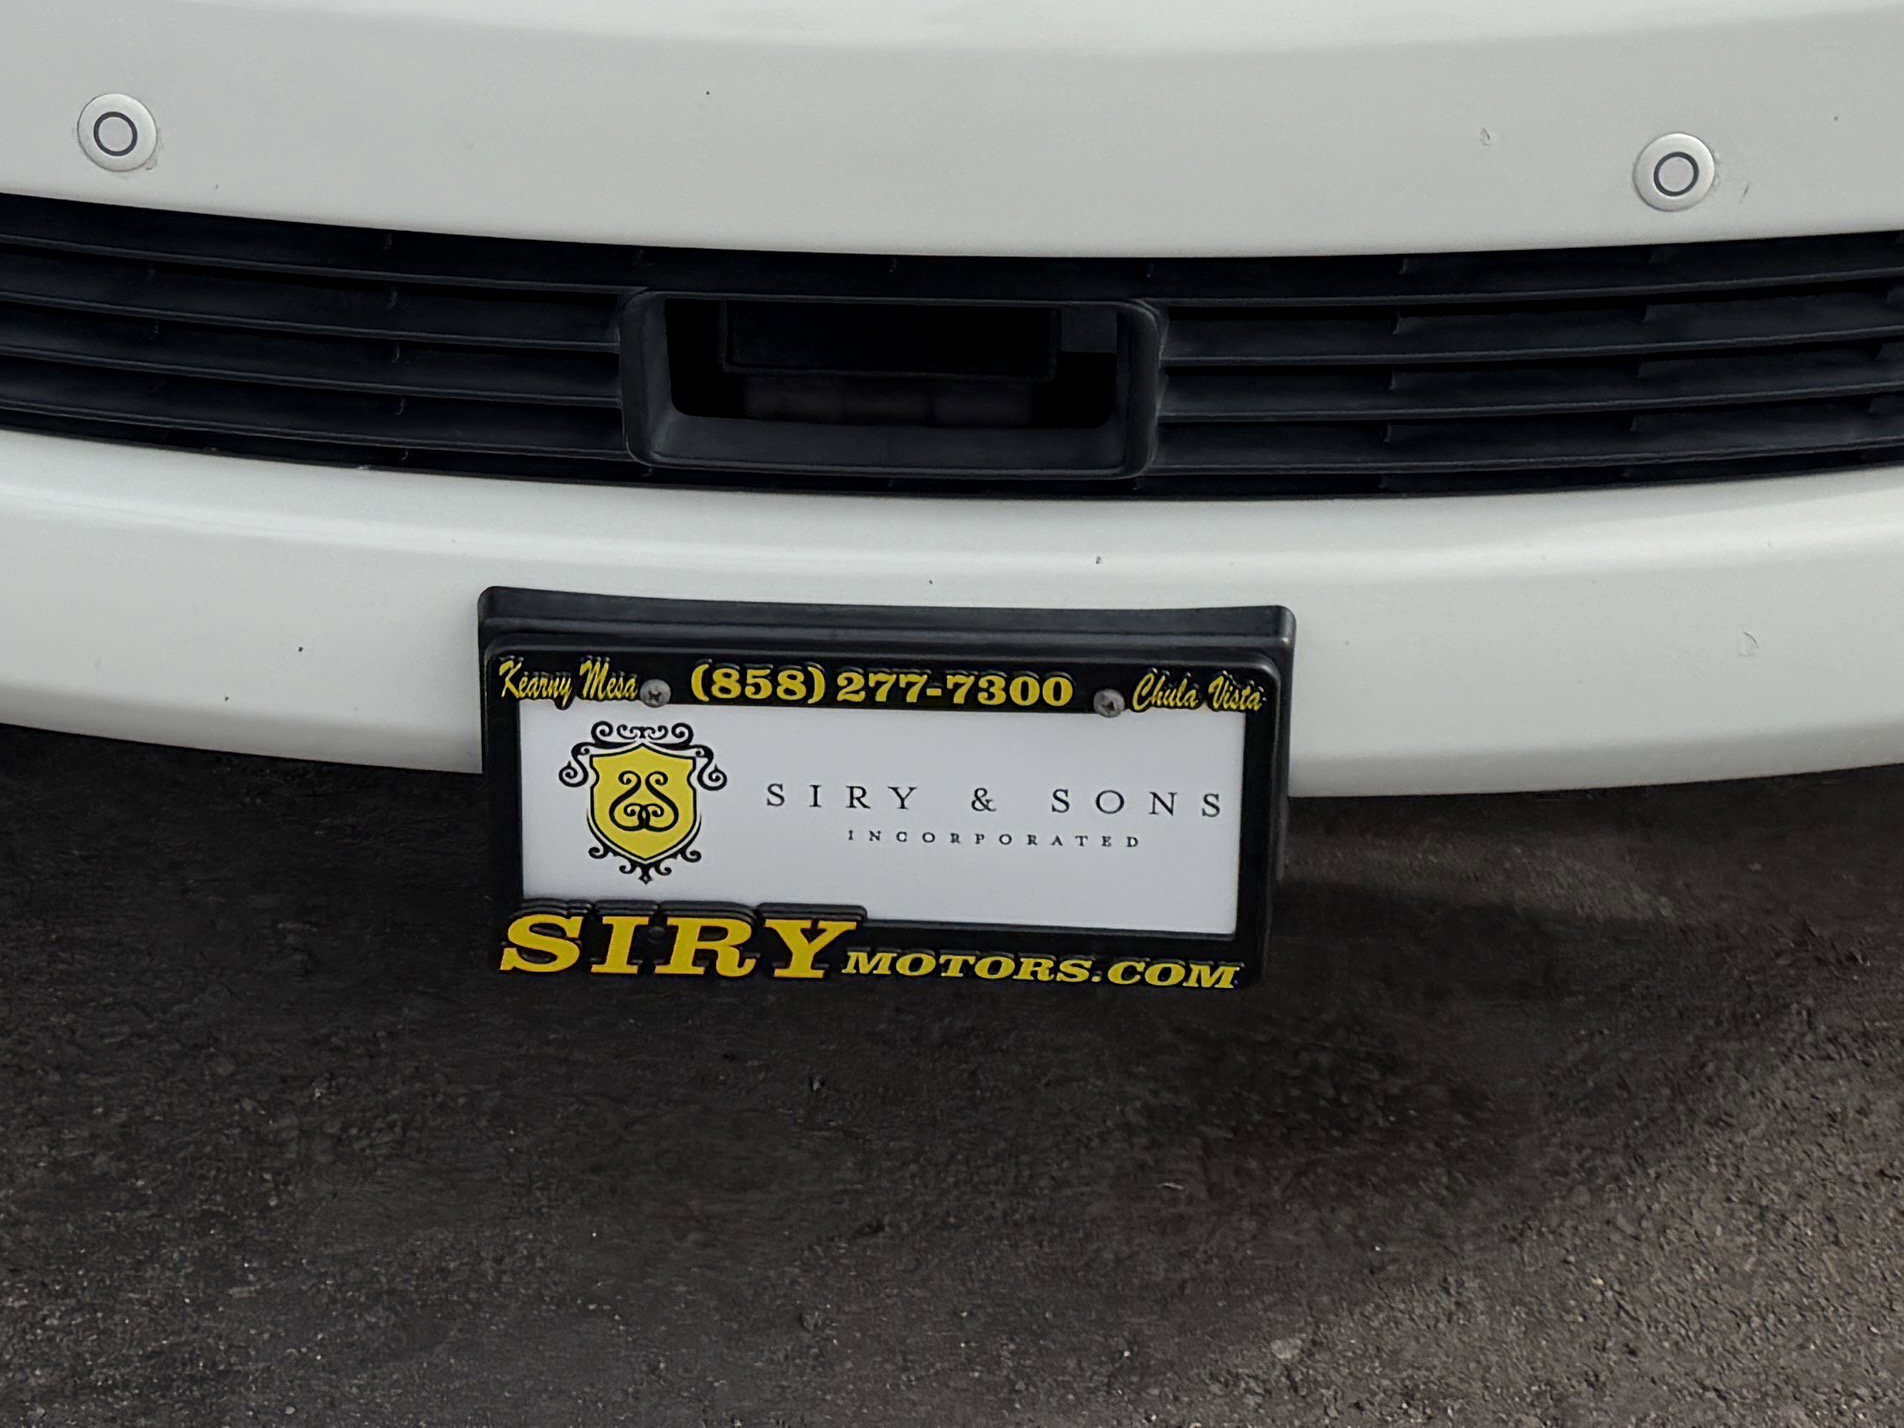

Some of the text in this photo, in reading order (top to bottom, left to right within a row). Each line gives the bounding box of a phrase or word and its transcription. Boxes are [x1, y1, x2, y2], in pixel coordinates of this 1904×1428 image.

[498, 660, 573, 709] Kearny
[580, 660, 639, 702] Mesa
[1132, 671, 1199, 711] Chula
[1207, 673, 1265, 712] Vista
[766, 782, 1223, 819] SIRY & SONS
[847, 828, 1140, 849] INCORPORATED
